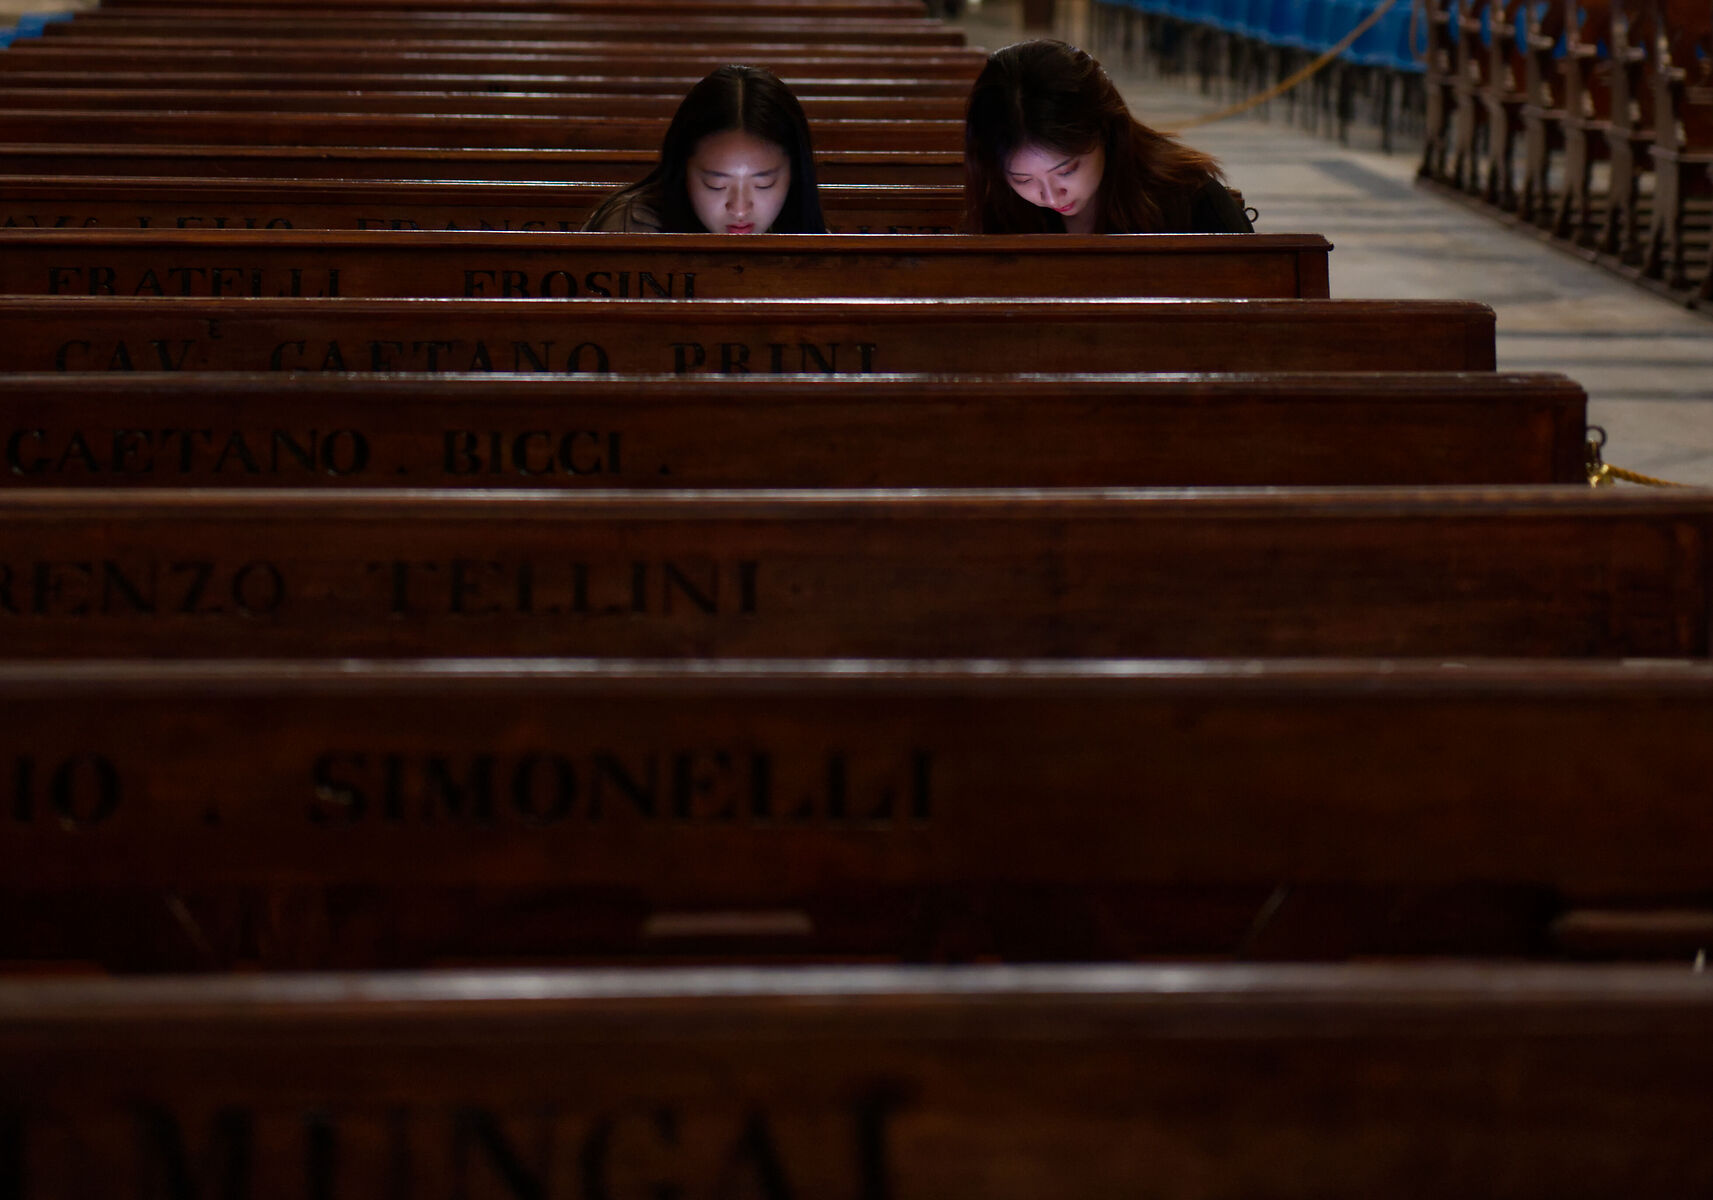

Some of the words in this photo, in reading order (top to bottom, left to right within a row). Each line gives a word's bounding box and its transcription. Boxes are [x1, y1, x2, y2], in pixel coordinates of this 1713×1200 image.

[50, 266, 340, 297] FRATELLI
[464, 270, 697, 299] FROSINI
[6, 427, 371, 477] GAETANO
[443, 430, 622, 476] BICCI
[367, 560, 758, 617] TELLINI
[308, 752, 932, 824] SIMONELLI
